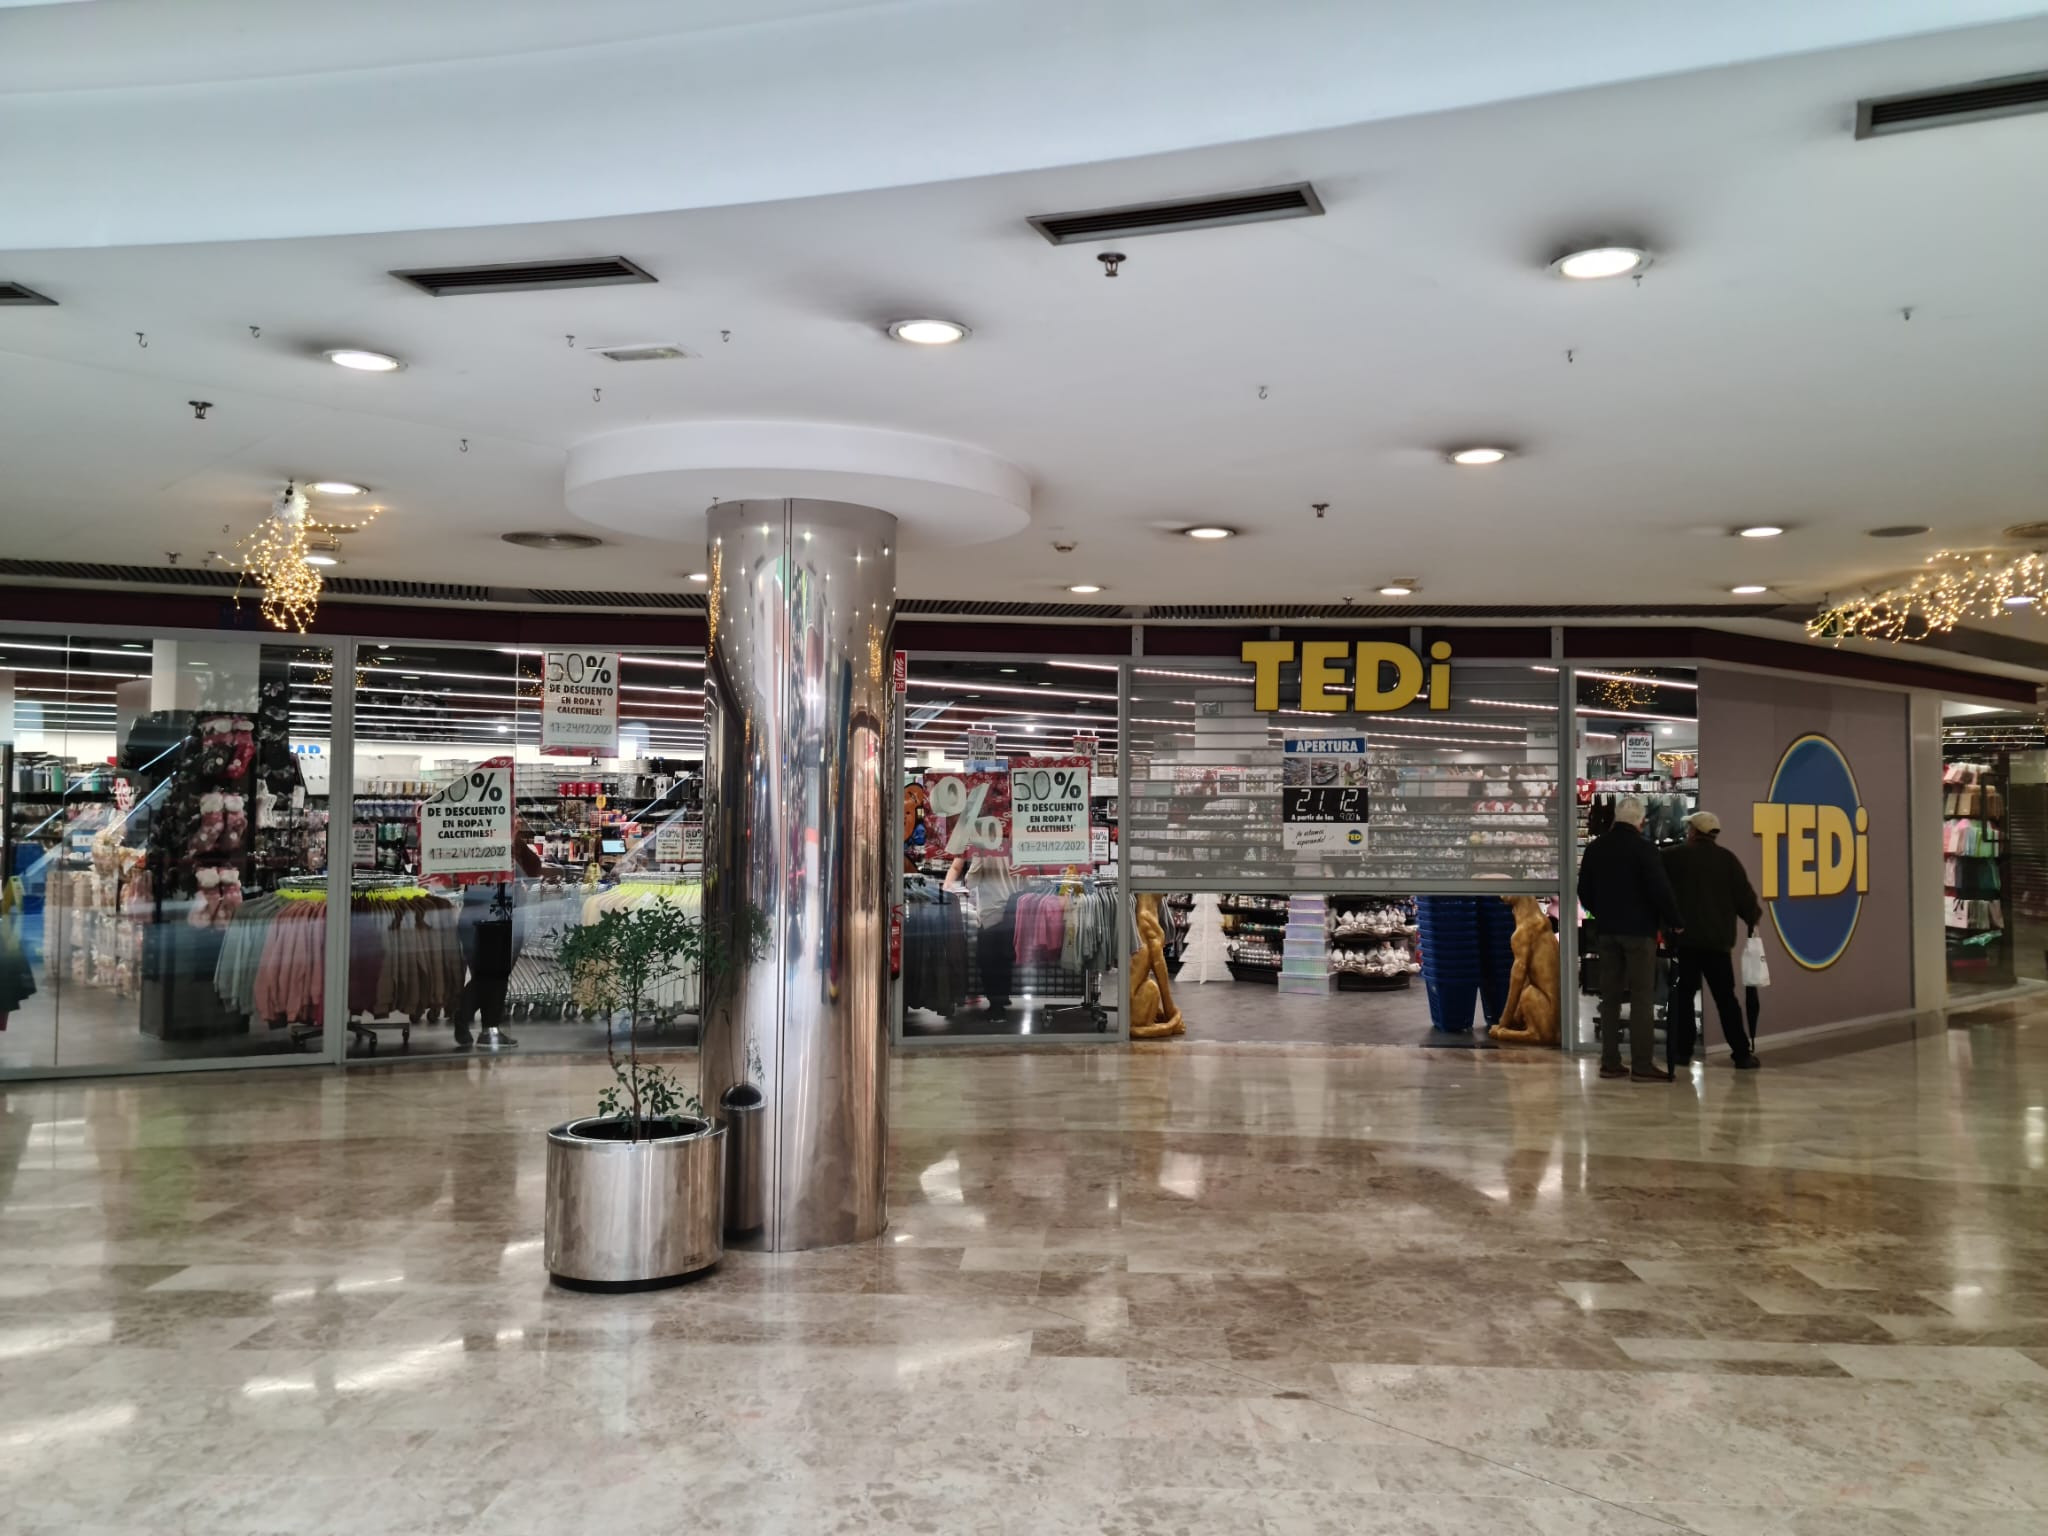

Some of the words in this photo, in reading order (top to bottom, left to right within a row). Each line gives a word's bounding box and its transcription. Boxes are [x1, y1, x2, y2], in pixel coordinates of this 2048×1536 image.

[546, 653, 611, 684] 50%
[1241, 641, 1452, 712] TEDi
[549, 684, 561, 693] DE
[563, 684, 614, 696] DESCUENTO
[561, 696, 571, 705] EN
[573, 697, 595, 706] ROPA
[597, 698, 602, 706] Y
[1296, 740, 1358, 753] APERTURA
[1013, 770, 1081, 800] 50%
[427, 807, 442, 817] DE
[445, 806, 506, 817] DESCUENTO
[1017, 803, 1030, 812] DE
[1032, 802, 1084, 812] DESCUENTO
[1030, 815, 1041, 823] EN
[1042, 815, 1065, 823] ROPA
[1067, 814, 1073, 822] Y
[1297, 813, 1314, 822] partir
[442, 820, 454, 828] EN
[457, 819, 483, 828] ROPA
[486, 819, 492, 827] Y
[1752, 802, 1868, 899] TEDi
